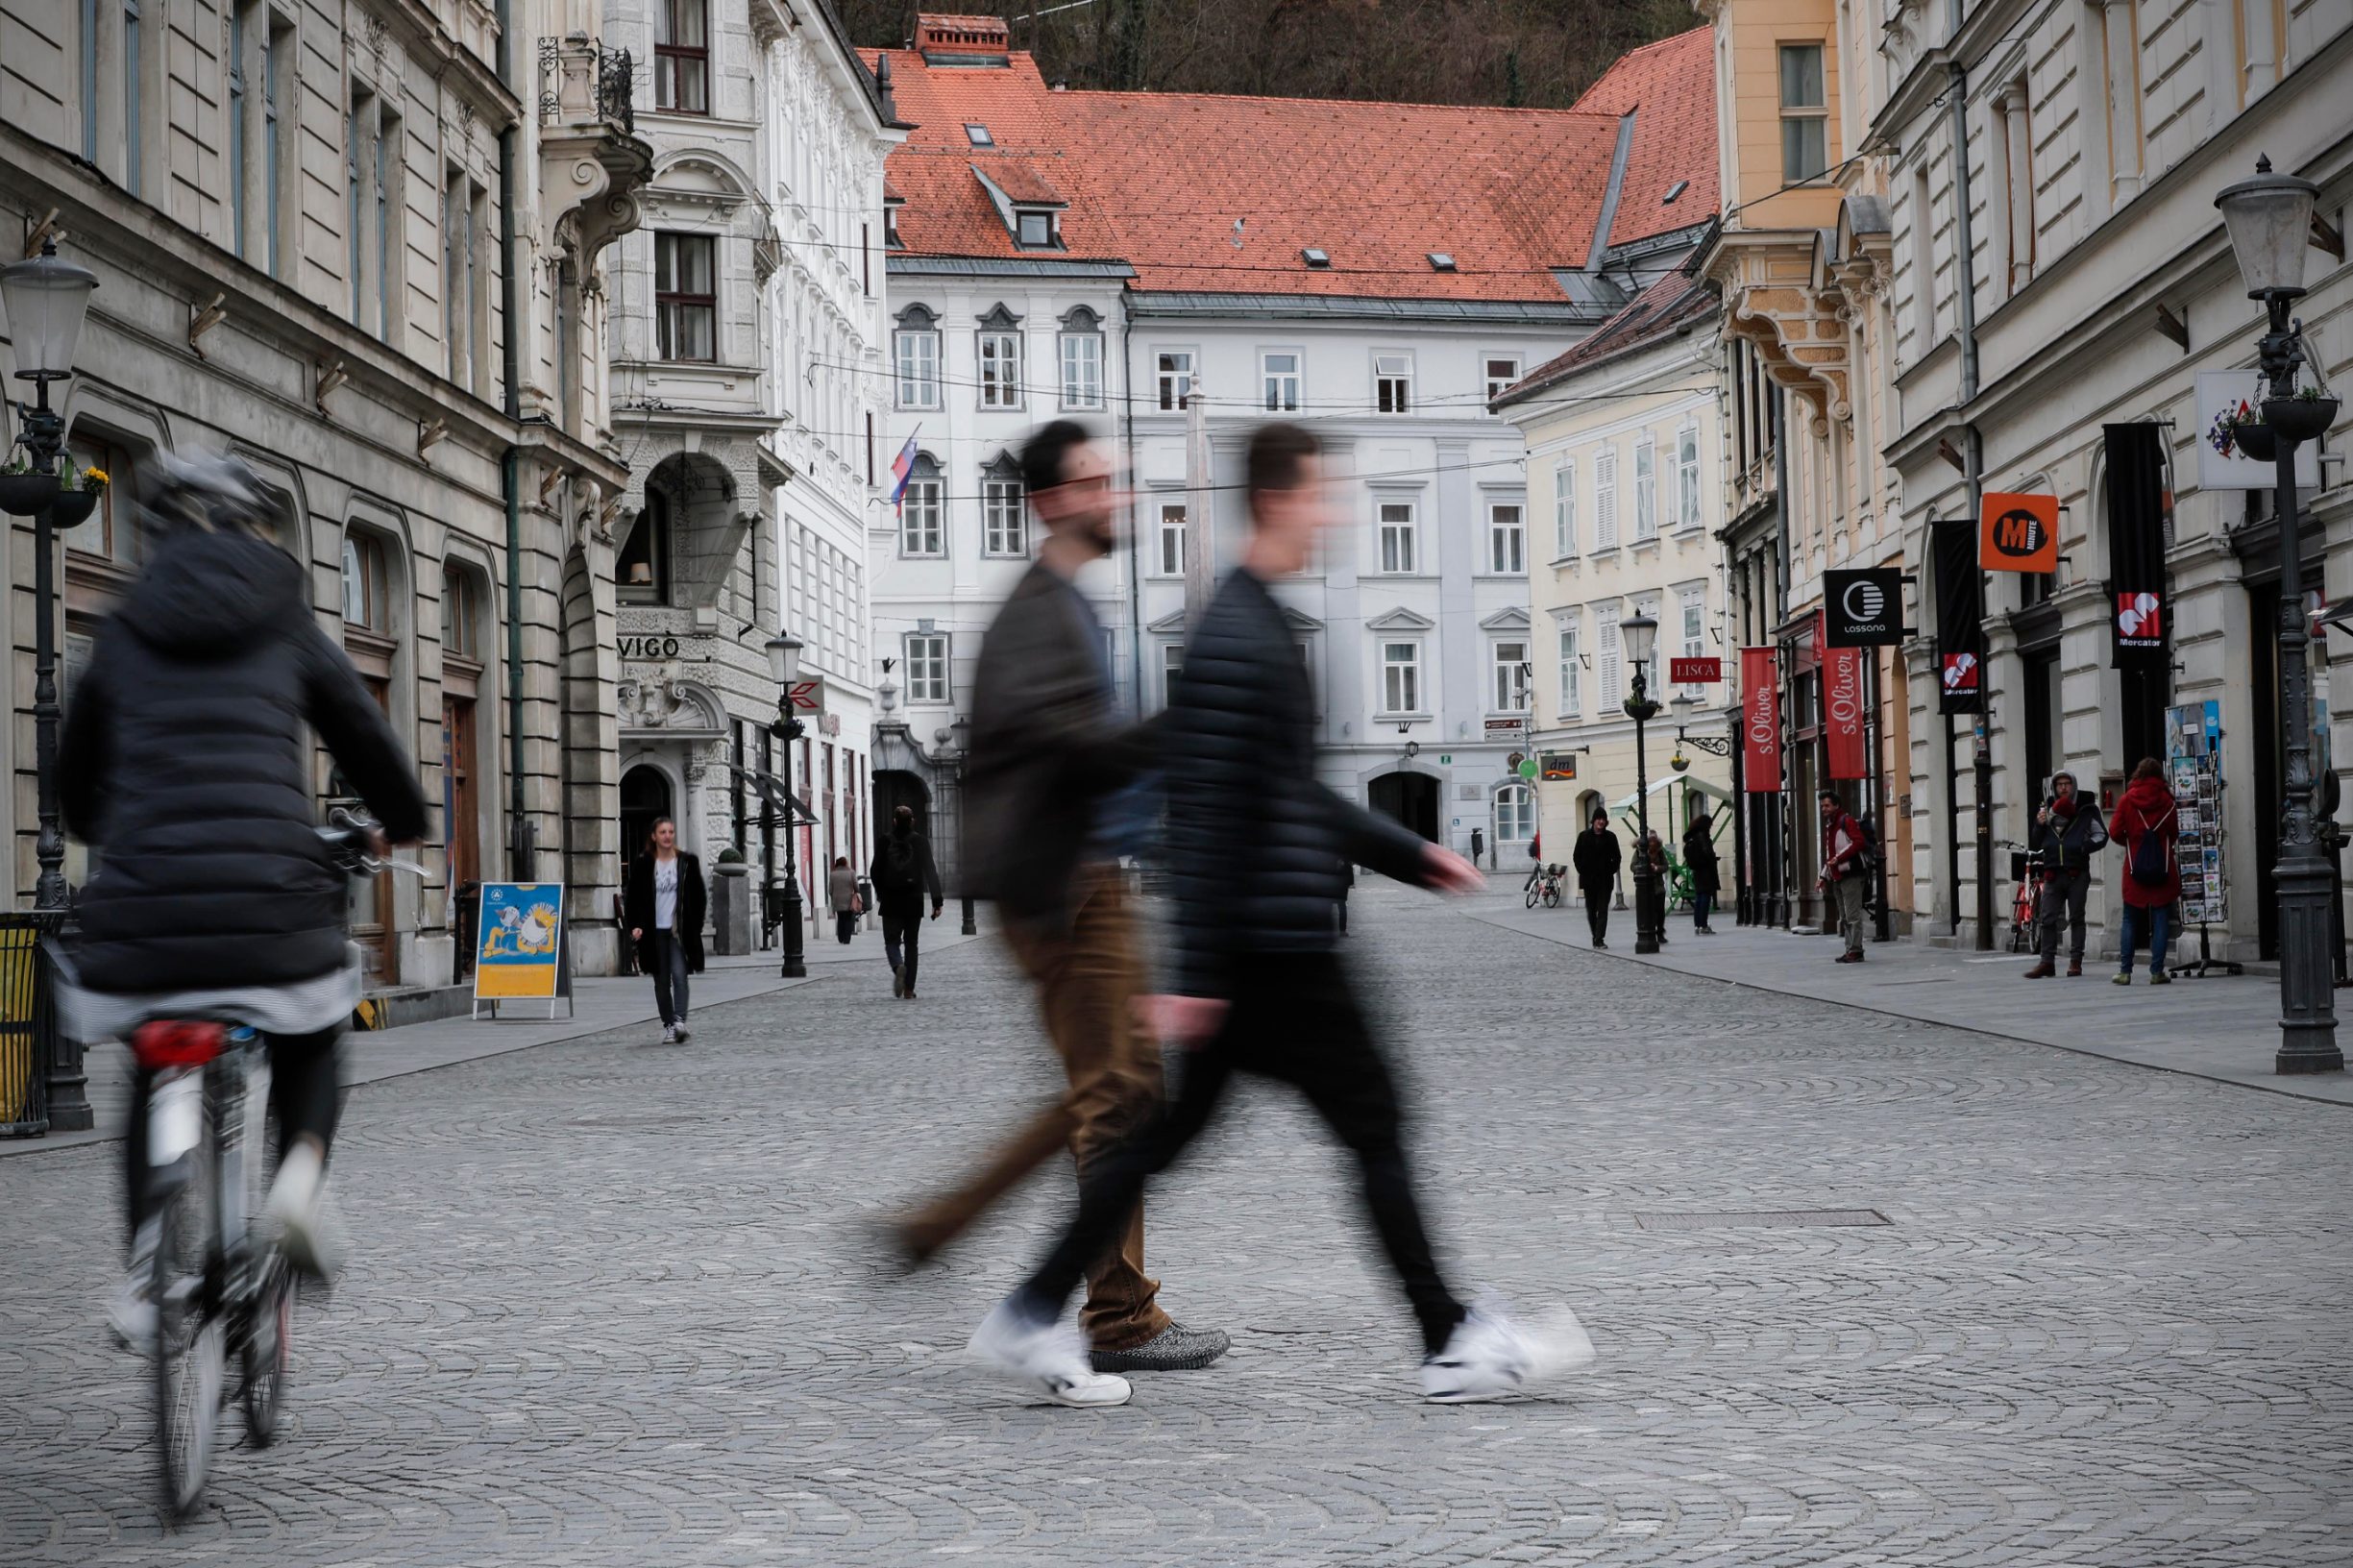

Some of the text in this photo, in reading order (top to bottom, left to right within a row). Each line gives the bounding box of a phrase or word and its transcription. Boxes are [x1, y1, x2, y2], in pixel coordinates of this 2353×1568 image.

[2027, 520, 2038, 551] MINUTE
[2119, 638, 2162, 648] Mercator
[1676, 664, 1715, 677] LISCA
[1831, 653, 1857, 735] s.Oliver
[1750, 683, 1774, 754] s.Oliver
[1549, 757, 1570, 771] dm
